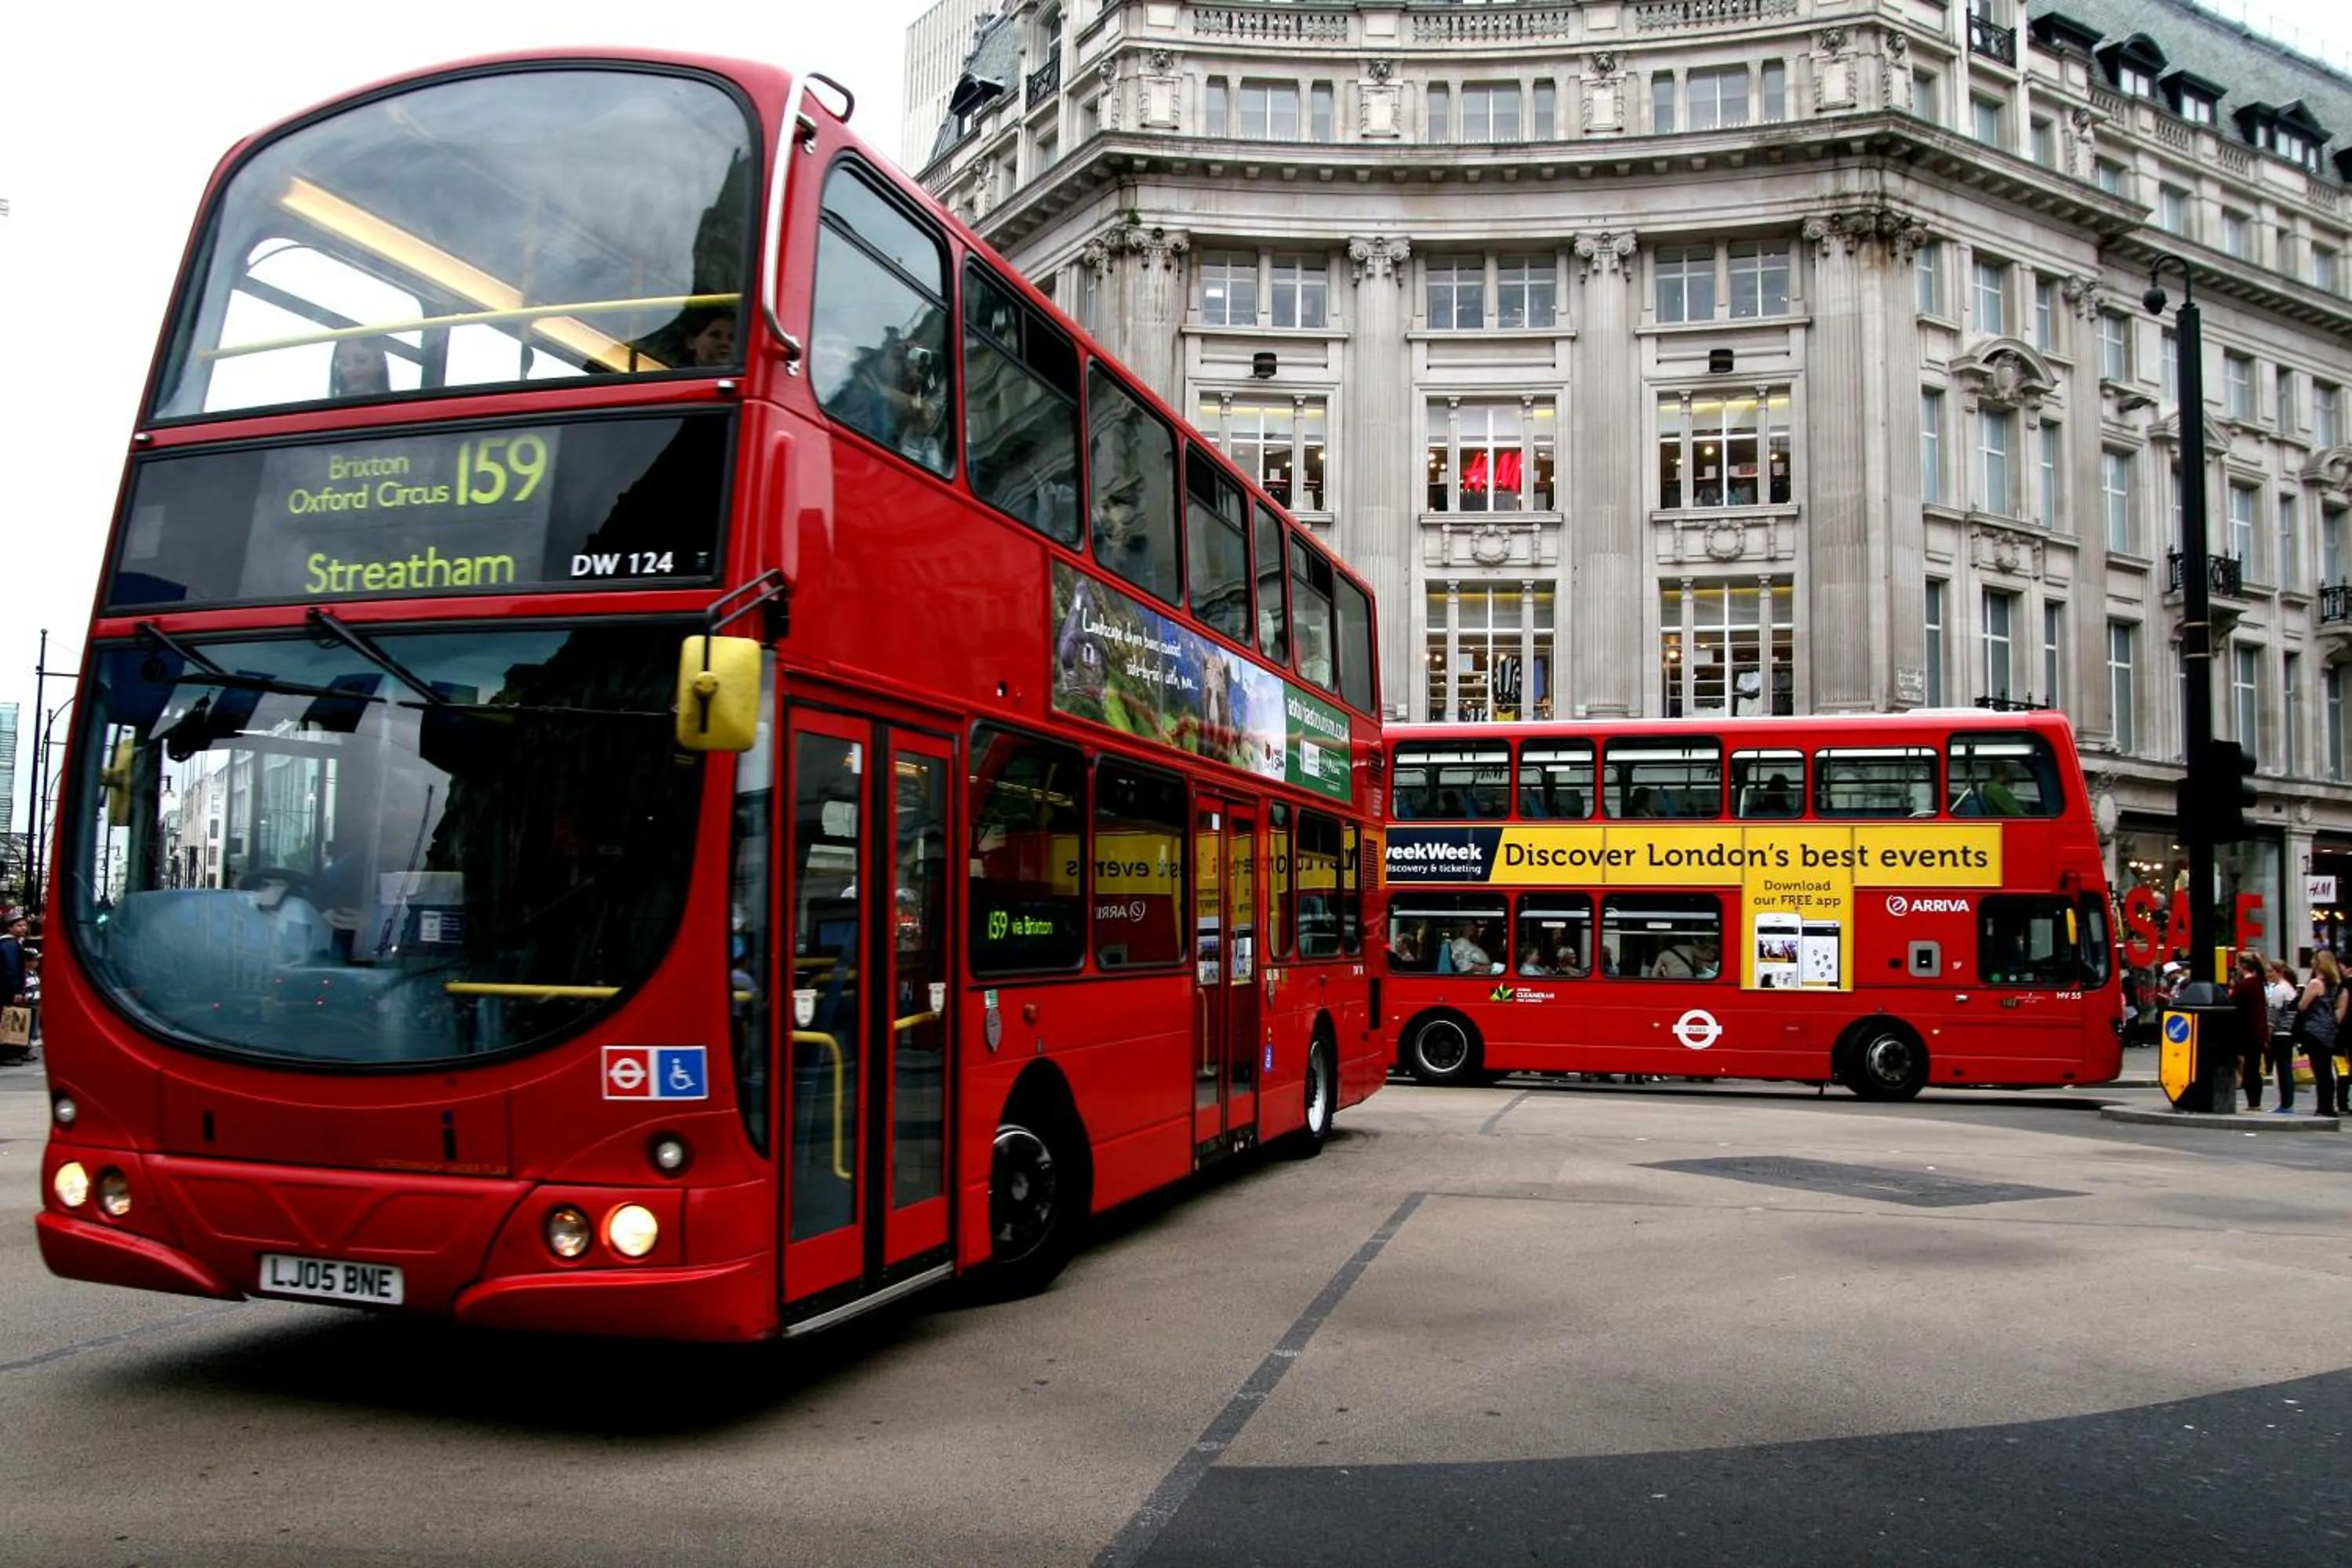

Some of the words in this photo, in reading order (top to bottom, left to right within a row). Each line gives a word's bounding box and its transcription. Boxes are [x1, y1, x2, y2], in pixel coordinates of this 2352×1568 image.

[329, 454, 410, 480] Brixton
[456, 433, 547, 506] 159
[1463, 452, 1525, 494] HM
[288, 484, 368, 514] Oxford
[376, 481, 450, 507] Circus
[305, 546, 515, 593] Streatham
[570, 553, 622, 576] DW
[628, 551, 674, 574] 124
[1504, 843, 1636, 866] Discover
[1646, 843, 1789, 867] London's
[1800, 844, 1868, 867] best
[1880, 845, 1988, 868] events
[1439, 863, 1482, 876] ticketing
[1763, 880, 1831, 891] Download
[1753, 896, 1776, 906] our
[1780, 895, 1813, 906] FREE
[1817, 896, 1841, 909] app
[1911, 899, 1970, 912] ARRIVA
[989, 911, 1007, 939] 159
[2126, 886, 2263, 969] SAE
[270, 1258, 337, 1291] LJ05
[343, 1265, 393, 1298] BNE
